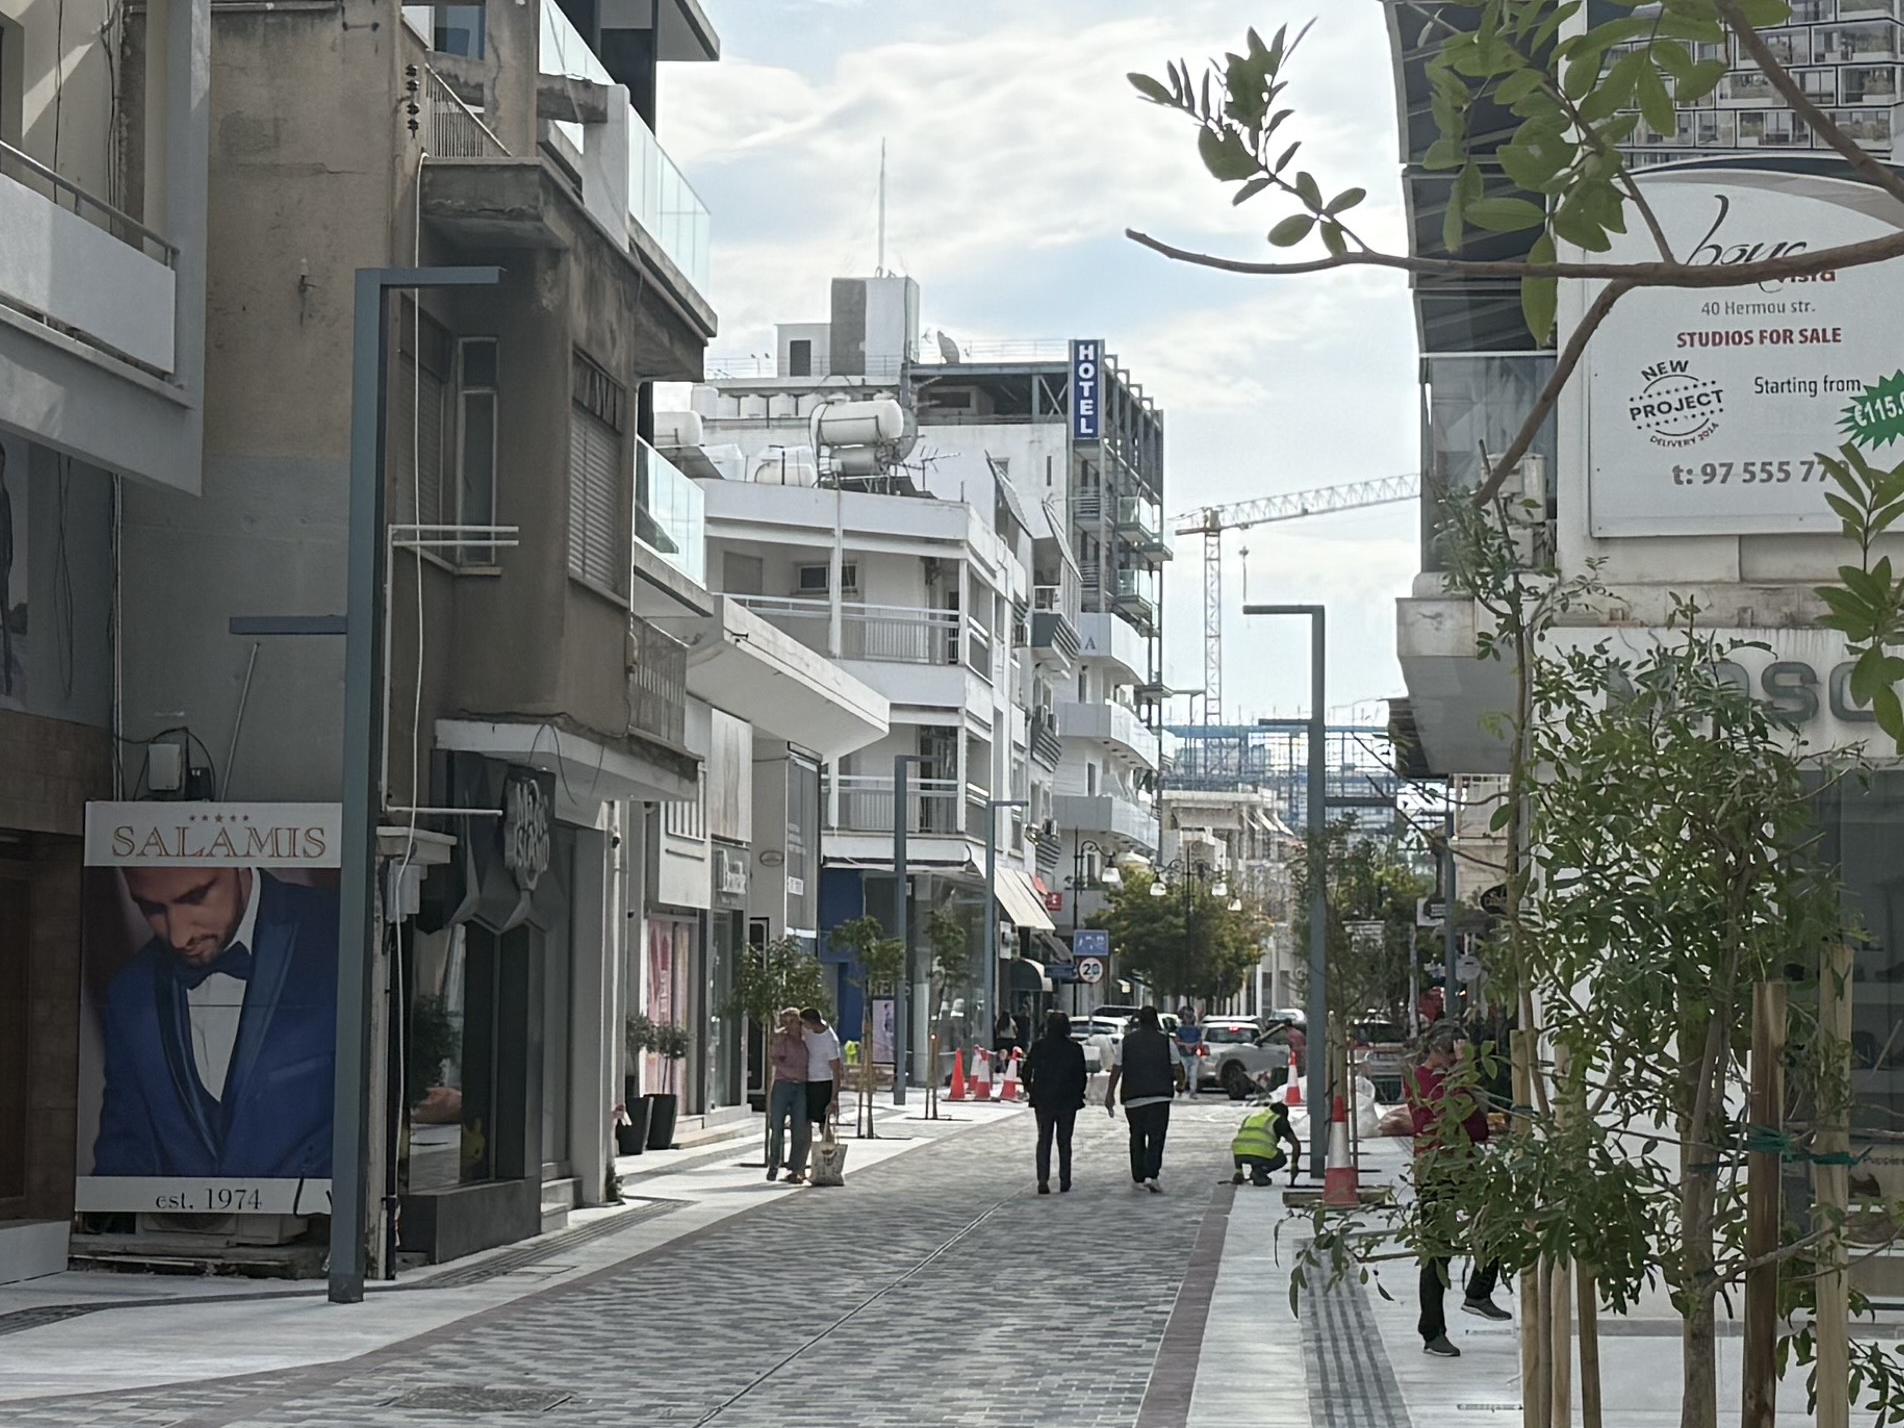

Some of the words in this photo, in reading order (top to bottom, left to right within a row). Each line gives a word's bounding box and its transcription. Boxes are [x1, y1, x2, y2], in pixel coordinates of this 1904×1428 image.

[1701, 302, 1720, 316] 40
[1725, 301, 1786, 316] Hermou
[1791, 300, 1816, 314] str.
[1677, 329, 1754, 348] STUDIOS
[1759, 329, 1794, 345] FOR
[1798, 327, 1842, 344] SALE
[1641, 359, 1689, 381] NEW
[1078, 343, 1096, 435] HOTEL
[1754, 376, 1819, 398] Starting
[1823, 375, 1862, 392] from
[1630, 390, 1724, 422] PROJECT
[1649, 435, 1696, 448] DELIVERY
[1698, 422, 1719, 440] 2014
[1671, 465, 1694, 485] t:
[1701, 462, 1733, 484] 97
[1741, 461, 1791, 483] 555
[111, 824, 327, 859] SALAMIS
[155, 1190, 194, 1210] est.
[205, 1188, 263, 1211] 1974
